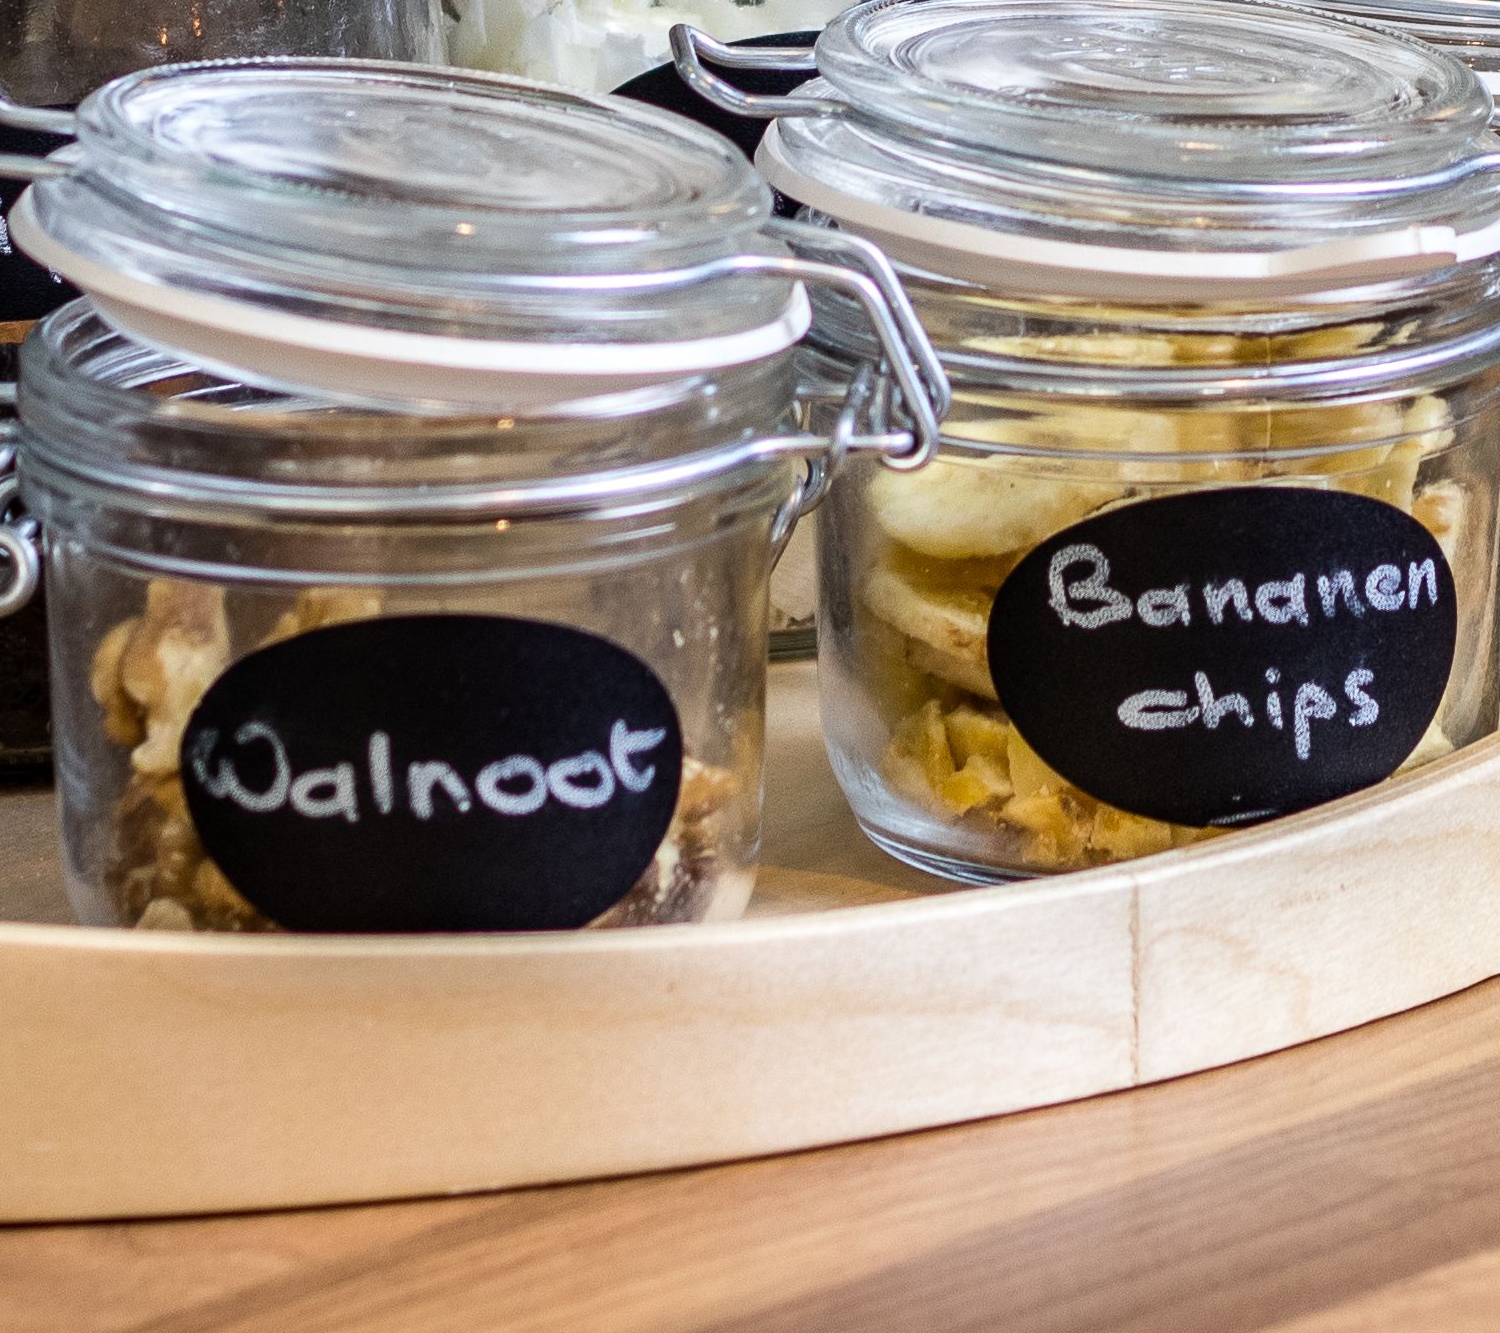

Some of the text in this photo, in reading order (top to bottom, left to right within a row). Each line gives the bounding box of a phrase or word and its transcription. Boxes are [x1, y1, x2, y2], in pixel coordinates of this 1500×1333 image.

[1046, 543, 1439, 630] Bananen
[1117, 664, 1380, 760] chips
[192, 718, 666, 823] Walnoot
